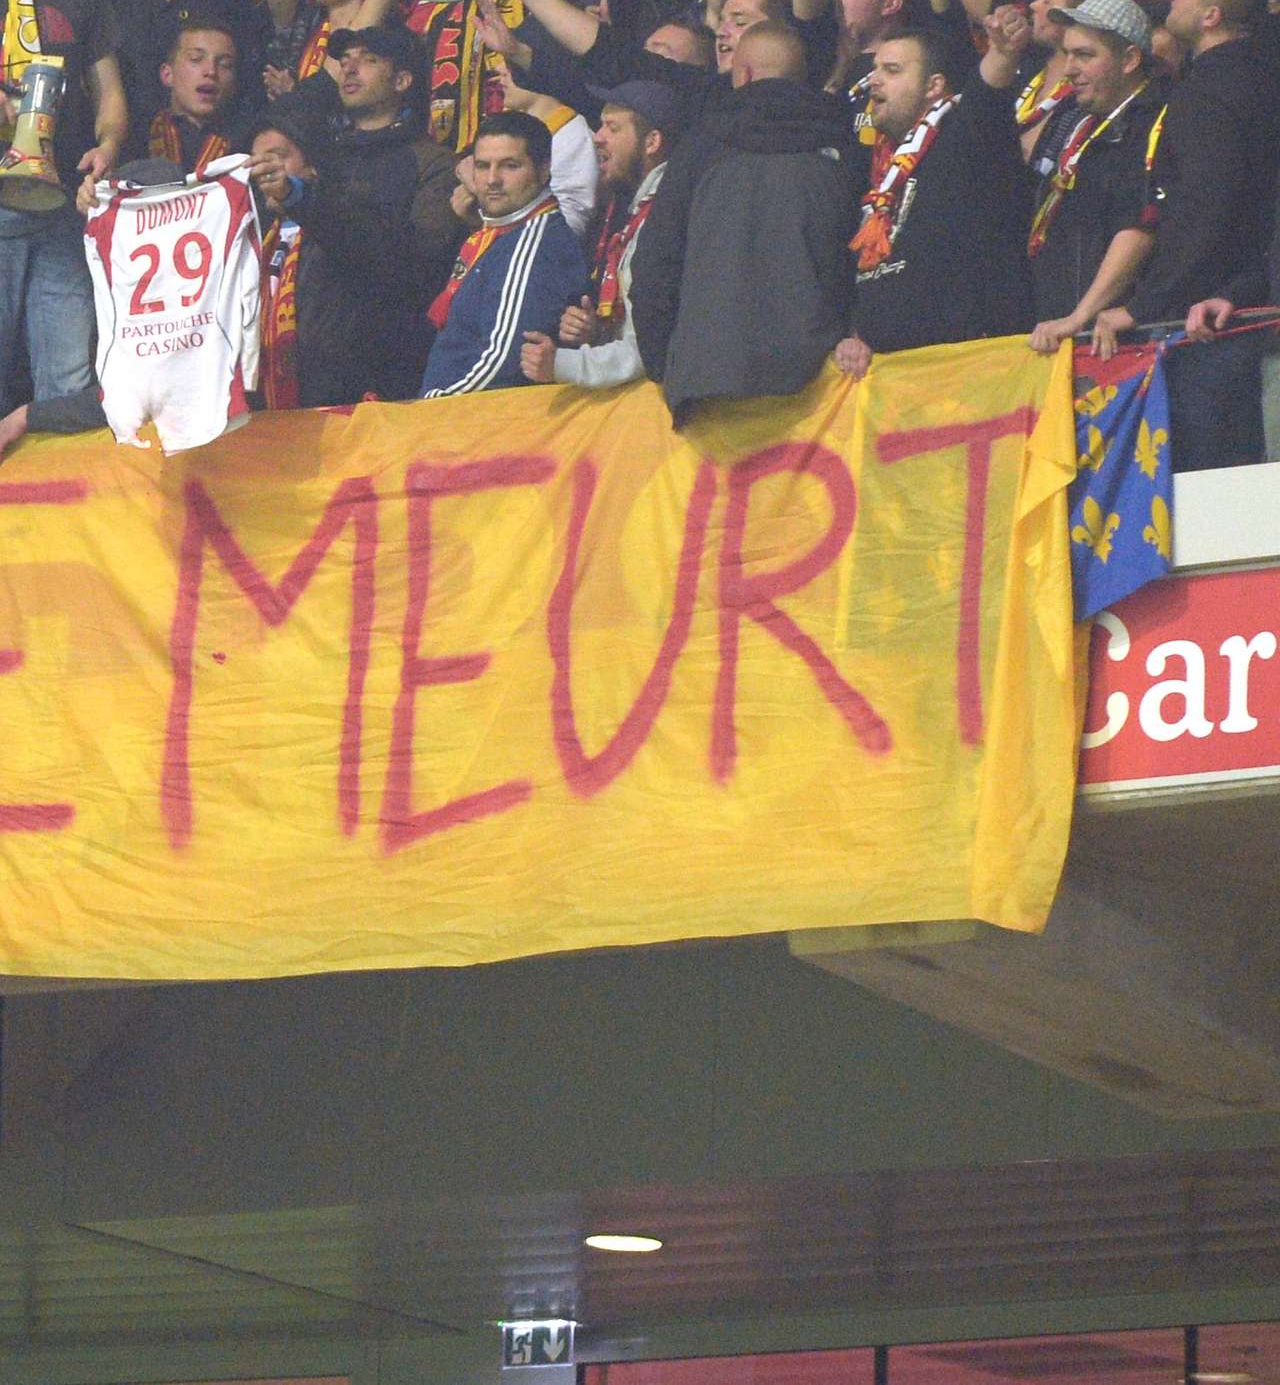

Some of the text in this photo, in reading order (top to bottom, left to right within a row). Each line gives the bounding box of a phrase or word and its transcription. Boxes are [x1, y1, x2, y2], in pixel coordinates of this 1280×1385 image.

[136, 192, 208, 235] DUMONT
[129, 231, 213, 316] 29
[122, 311, 215, 339] PARTOUCHE
[136, 331, 204, 358] CASINO
[160, 405, 1040, 855] MEURT
